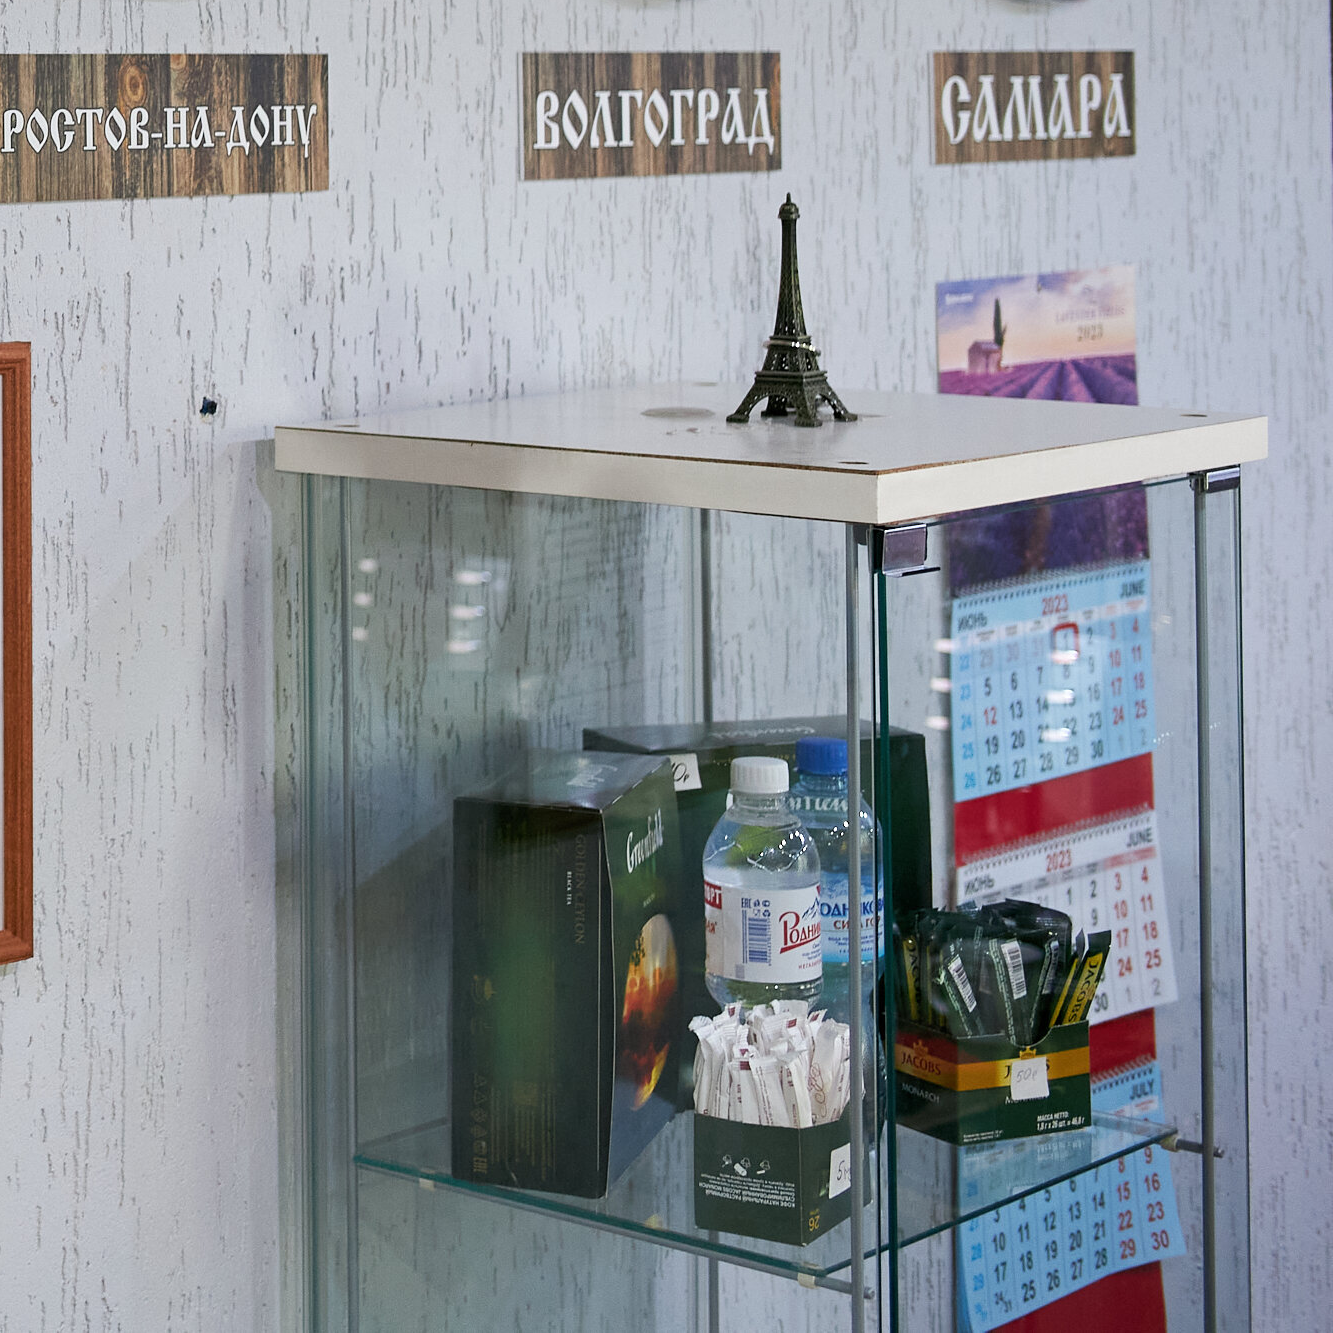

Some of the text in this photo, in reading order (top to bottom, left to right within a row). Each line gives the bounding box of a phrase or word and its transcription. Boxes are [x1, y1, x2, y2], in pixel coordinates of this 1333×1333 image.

[941, 72, 1132, 146] САМАРА
[0, 104, 318, 159] РОСТОВ-НА-ДОНУ
[532, 87, 775, 157] ВОЛГОГРАД
[1120, 579, 1145, 598] JUNE
[1042, 594, 1068, 615] 2023
[957, 612, 988, 632] ИЮНЬ
[1127, 827, 1153, 848] JUNE
[1046, 849, 1072, 873] 2023
[1118, 949, 1162, 978] 24 25
[901, 1052, 942, 1076] JACOBS
[901, 1082, 940, 1103] MONARCH
[1130, 1078, 1155, 1100] JULY
[1118, 1202, 1164, 1231] 22 23
